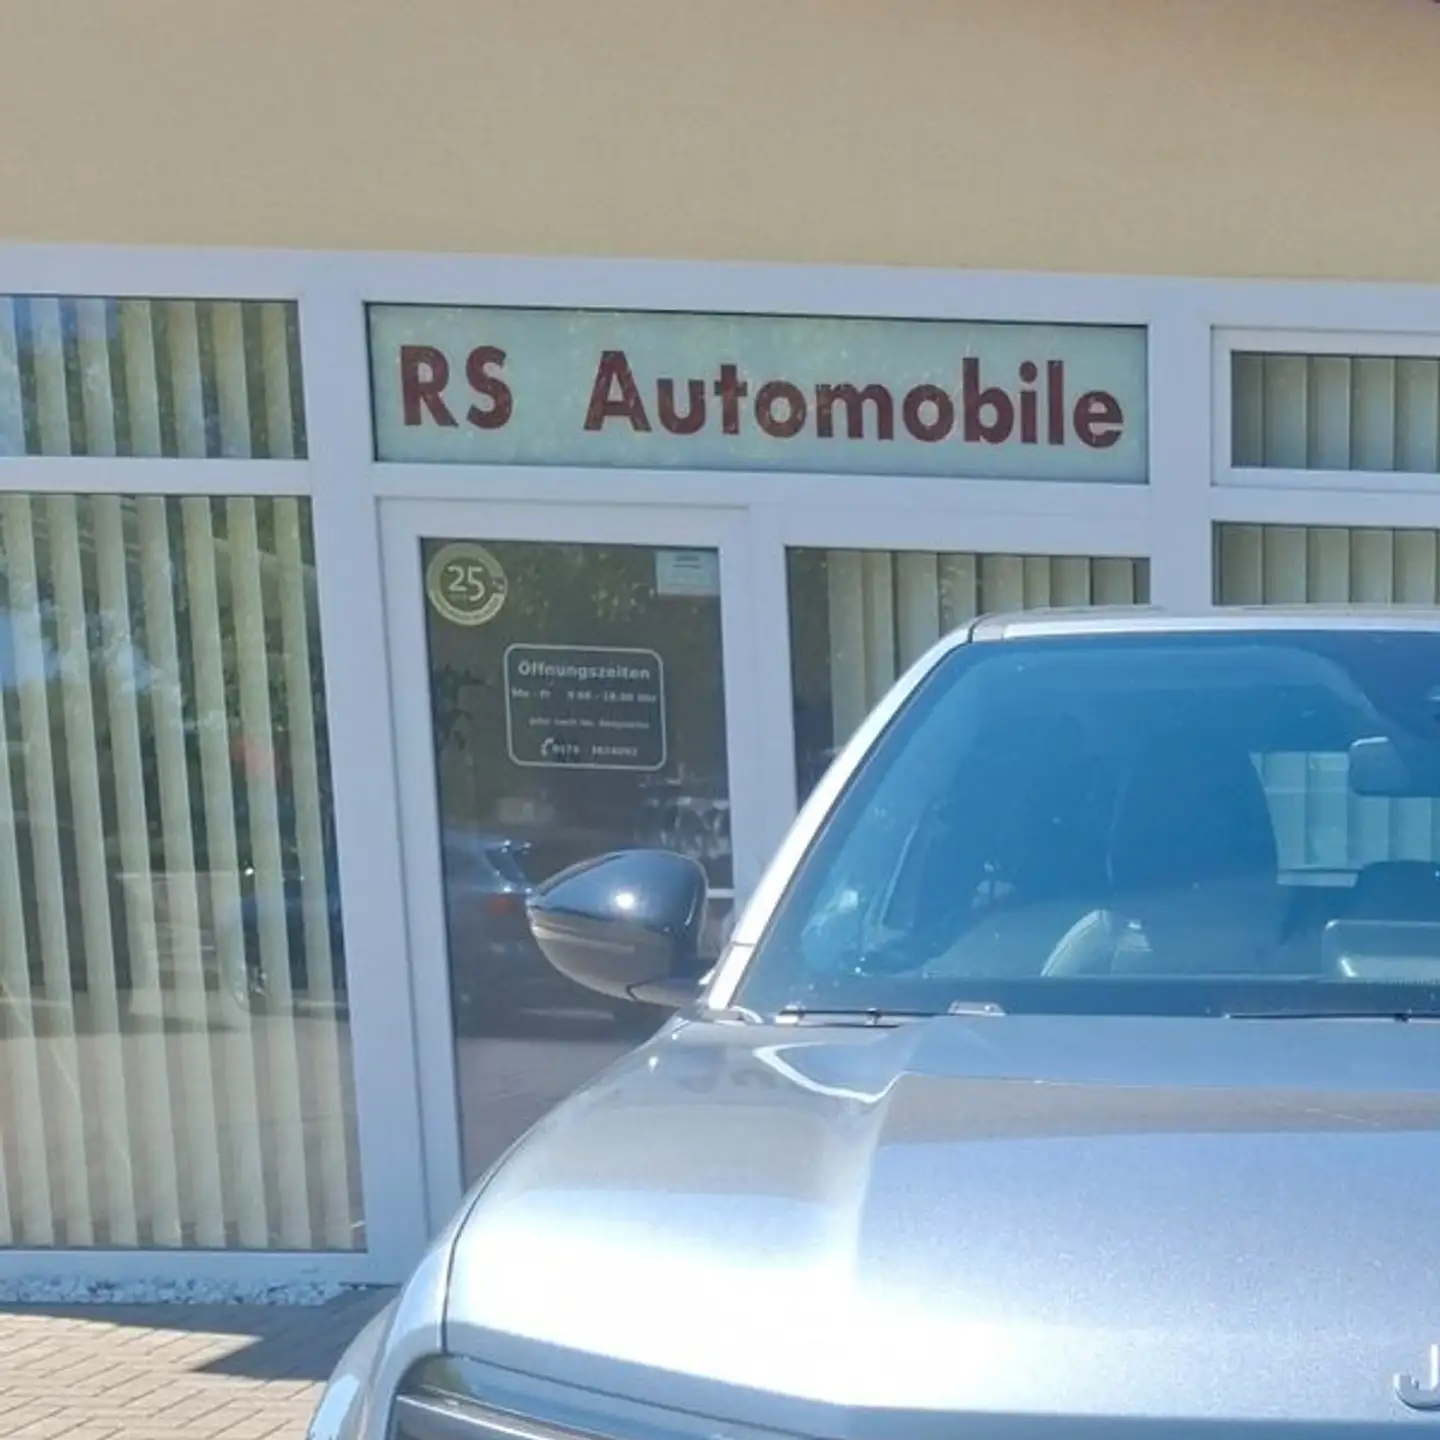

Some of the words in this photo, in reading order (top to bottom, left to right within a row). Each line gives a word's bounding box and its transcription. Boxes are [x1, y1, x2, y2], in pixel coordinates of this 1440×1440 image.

[399, 344, 514, 431] RS
[583, 349, 1125, 448] Automobile
[447, 565, 487, 602] 25
